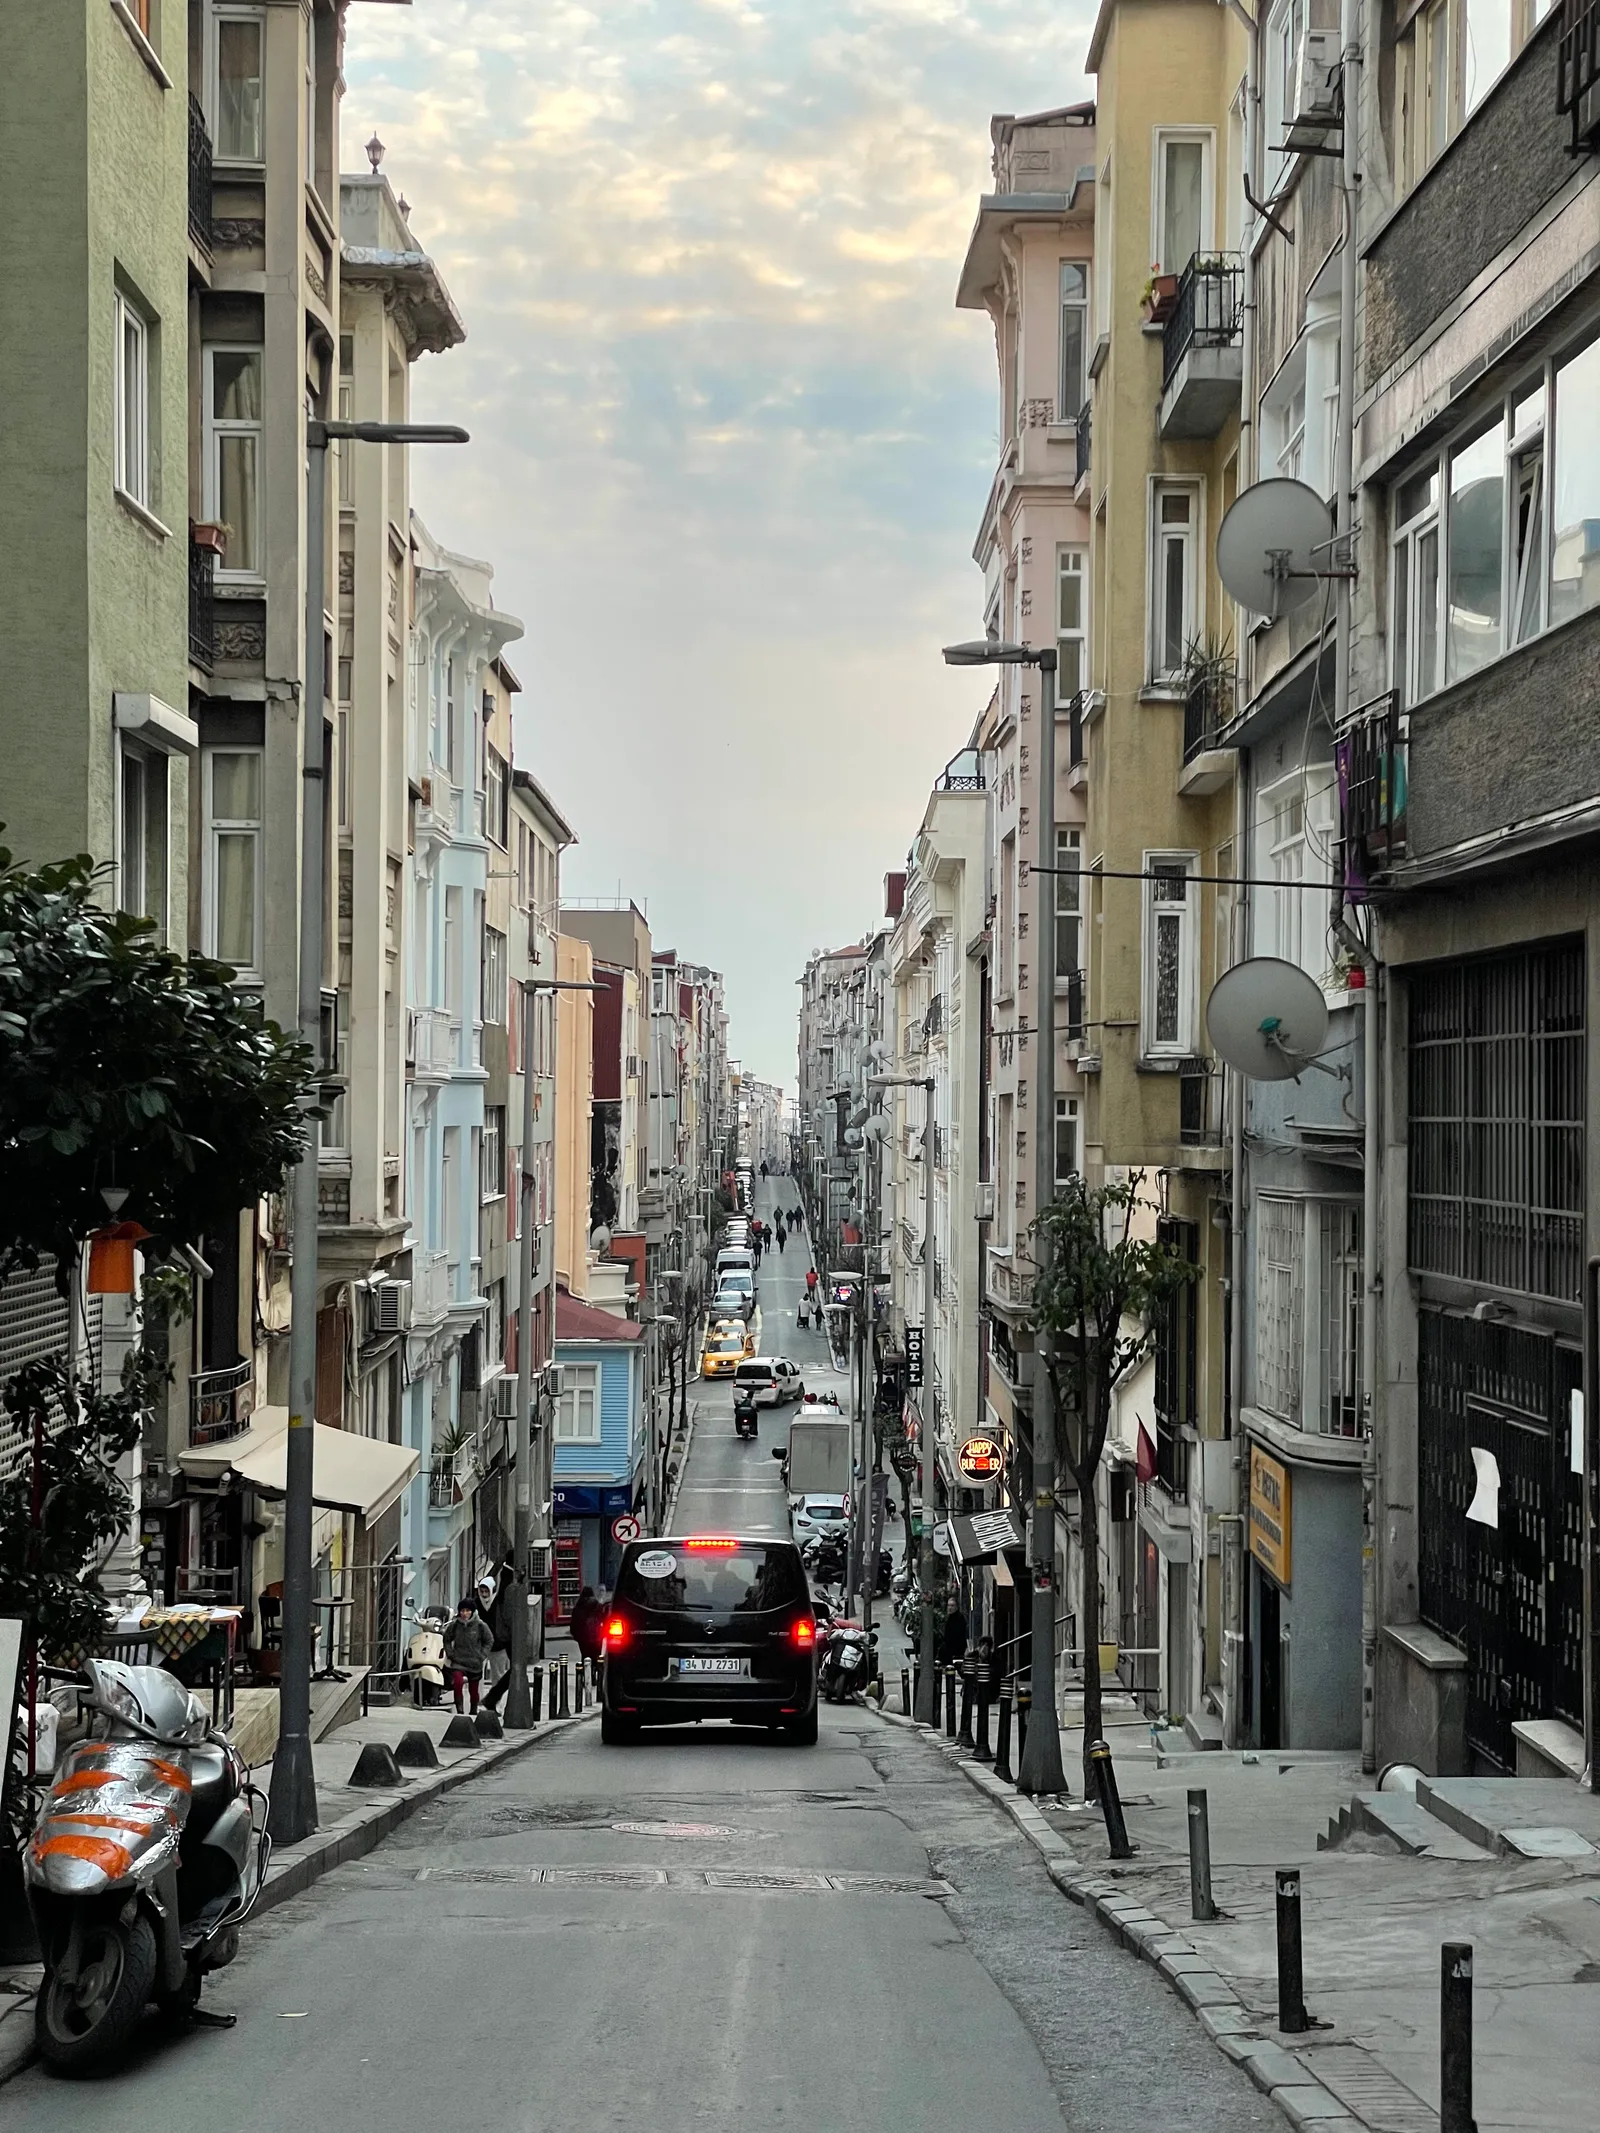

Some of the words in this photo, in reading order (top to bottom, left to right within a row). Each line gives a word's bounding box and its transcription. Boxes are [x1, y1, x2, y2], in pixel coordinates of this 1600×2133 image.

[908, 1331, 920, 1382] HOTEL
[967, 1442, 992, 1455] HAPPY
[685, 1660, 697, 1669] 34
[701, 1660, 712, 1669] VJ
[716, 1660, 738, 1669] 2731
